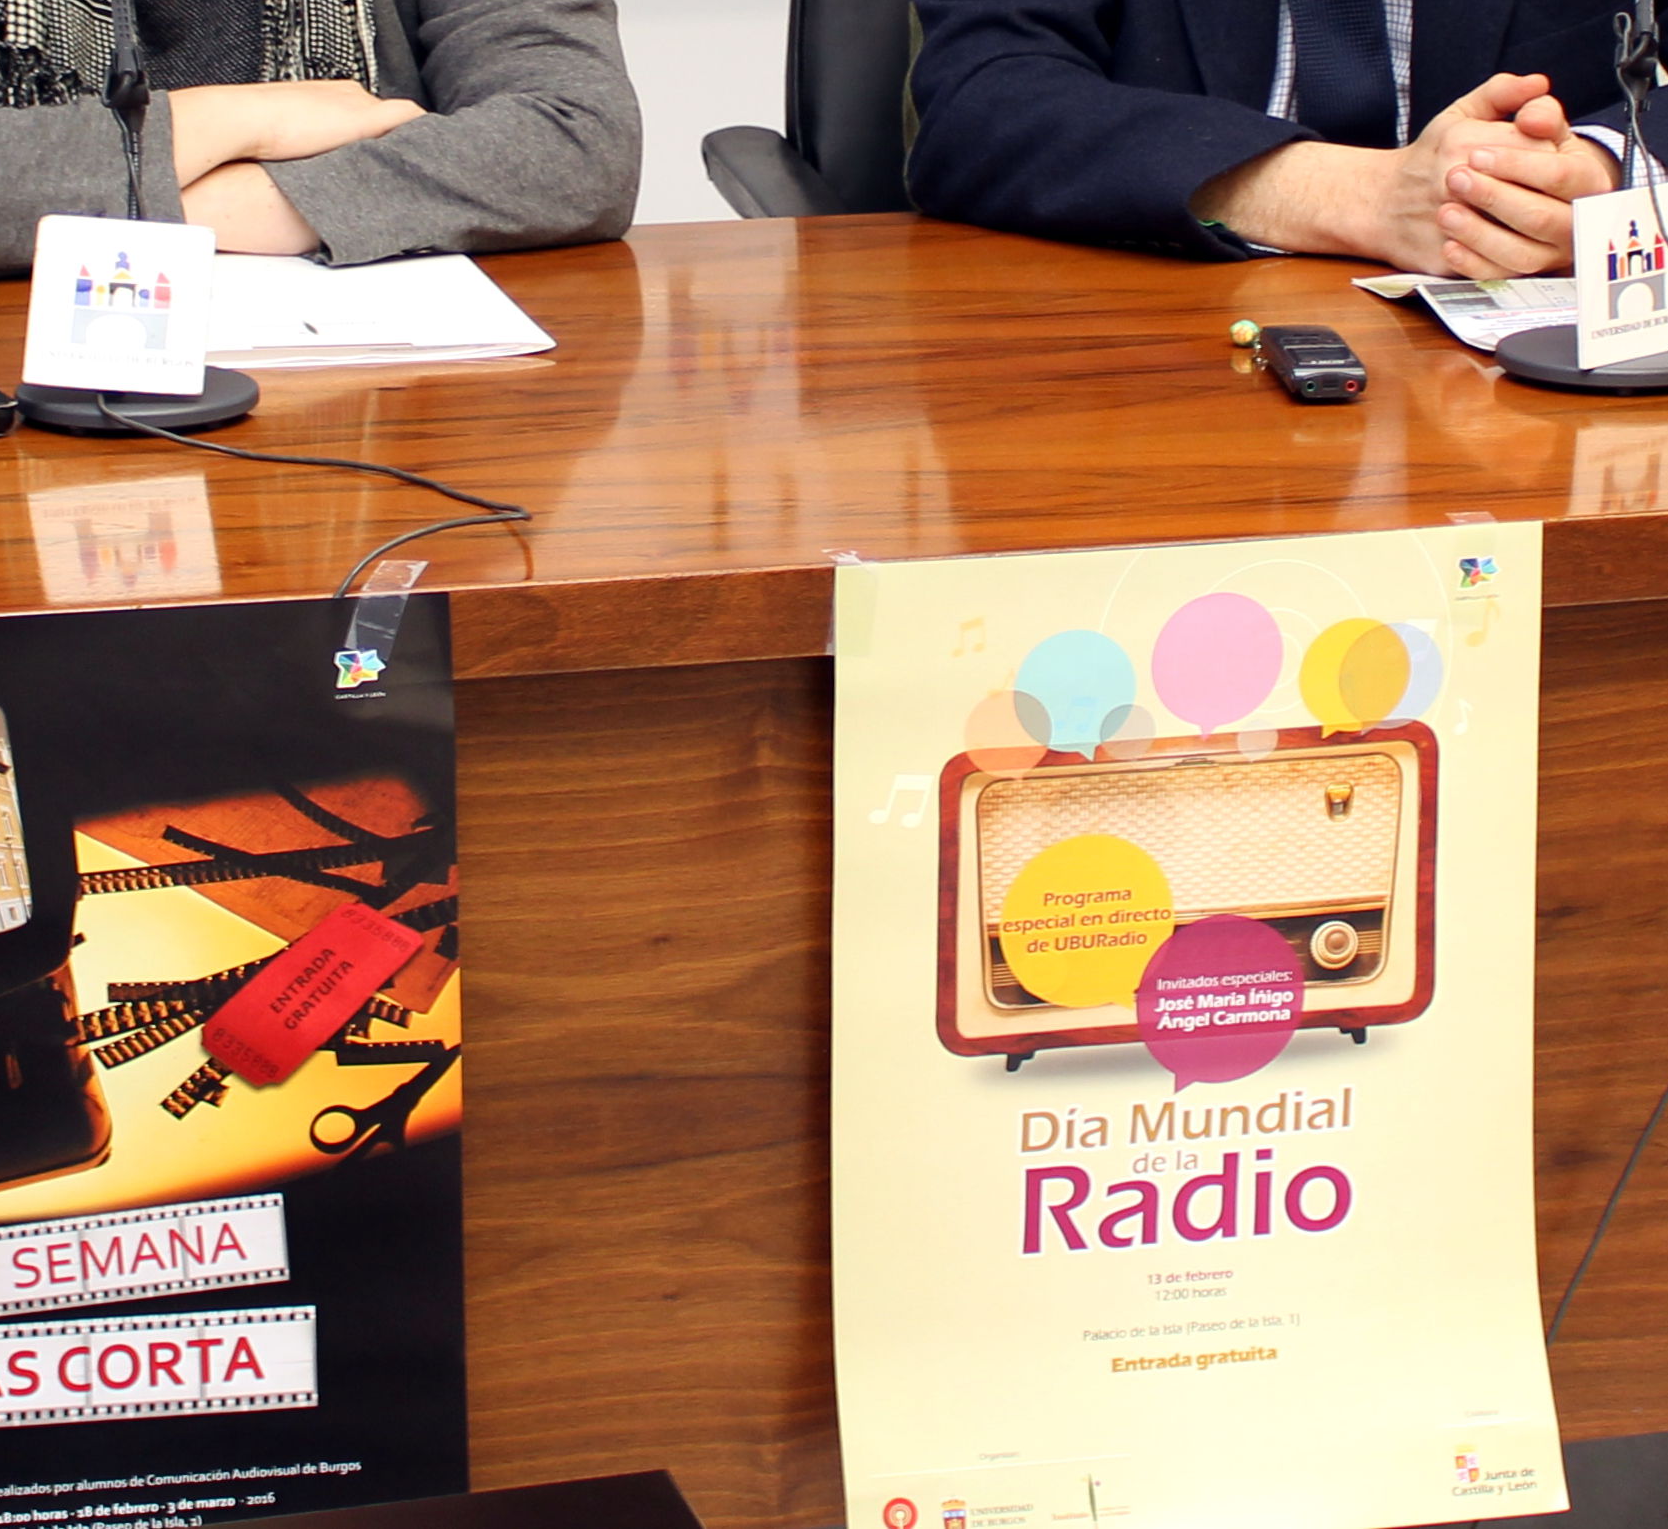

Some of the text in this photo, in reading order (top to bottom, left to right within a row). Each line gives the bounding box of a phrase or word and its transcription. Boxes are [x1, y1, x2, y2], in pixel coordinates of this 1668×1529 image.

[1043, 889, 1132, 909] Programa
[1003, 907, 1172, 935] especial en directo
[1026, 932, 1148, 954] de UBURadio
[268, 947, 337, 1014] ENTRADA
[1156, 970, 1293, 991] Invitados especiales:
[283, 960, 355, 1031] GRATUITA
[1154, 995, 1195, 1013] José
[1156, 1008, 1292, 1032] Ángel Carmona
[1020, 1087, 1352, 1153] Día Mundial
[1132, 1150, 1199, 1174] de la
[1022, 1148, 1353, 1255] Radio
[12, 1221, 248, 1289] SEMANA
[1147, 1269, 1234, 1285] 13 de febrero
[1155, 1286, 1228, 1302] 12:00 horas
[1083, 1328, 1128, 1342] Palacio
[1130, 1326, 1146, 1338] de
[1148, 1325, 1161, 1336] la
[1229, 1317, 1246, 1330] de
[1248, 1317, 1260, 1328] la
[57, 1336, 265, 1393] CORTA
[1111, 1346, 1279, 1373] Entrada gratuita
[54, 1482, 74, 1496] por
[76, 1477, 128, 1492] alumnos
[130, 1475, 145, 1488] de
[146, 1468, 231, 1487] Comunicación
[232, 1463, 301, 1481] Audiovisual
[302, 1462, 317, 1475] de
[318, 1460, 362, 1475] Burgos
[1484, 1467, 1536, 1481] Junta de
[32, 1508, 69, 1522] horas
[94, 1504, 111, 1517] de
[112, 1501, 160, 1516] febrero
[167, 1502, 176, 1515] 3
[178, 1498, 194, 1511] de
[196, 1497, 236, 1510] marzo
[247, 1491, 276, 1505] 2016
